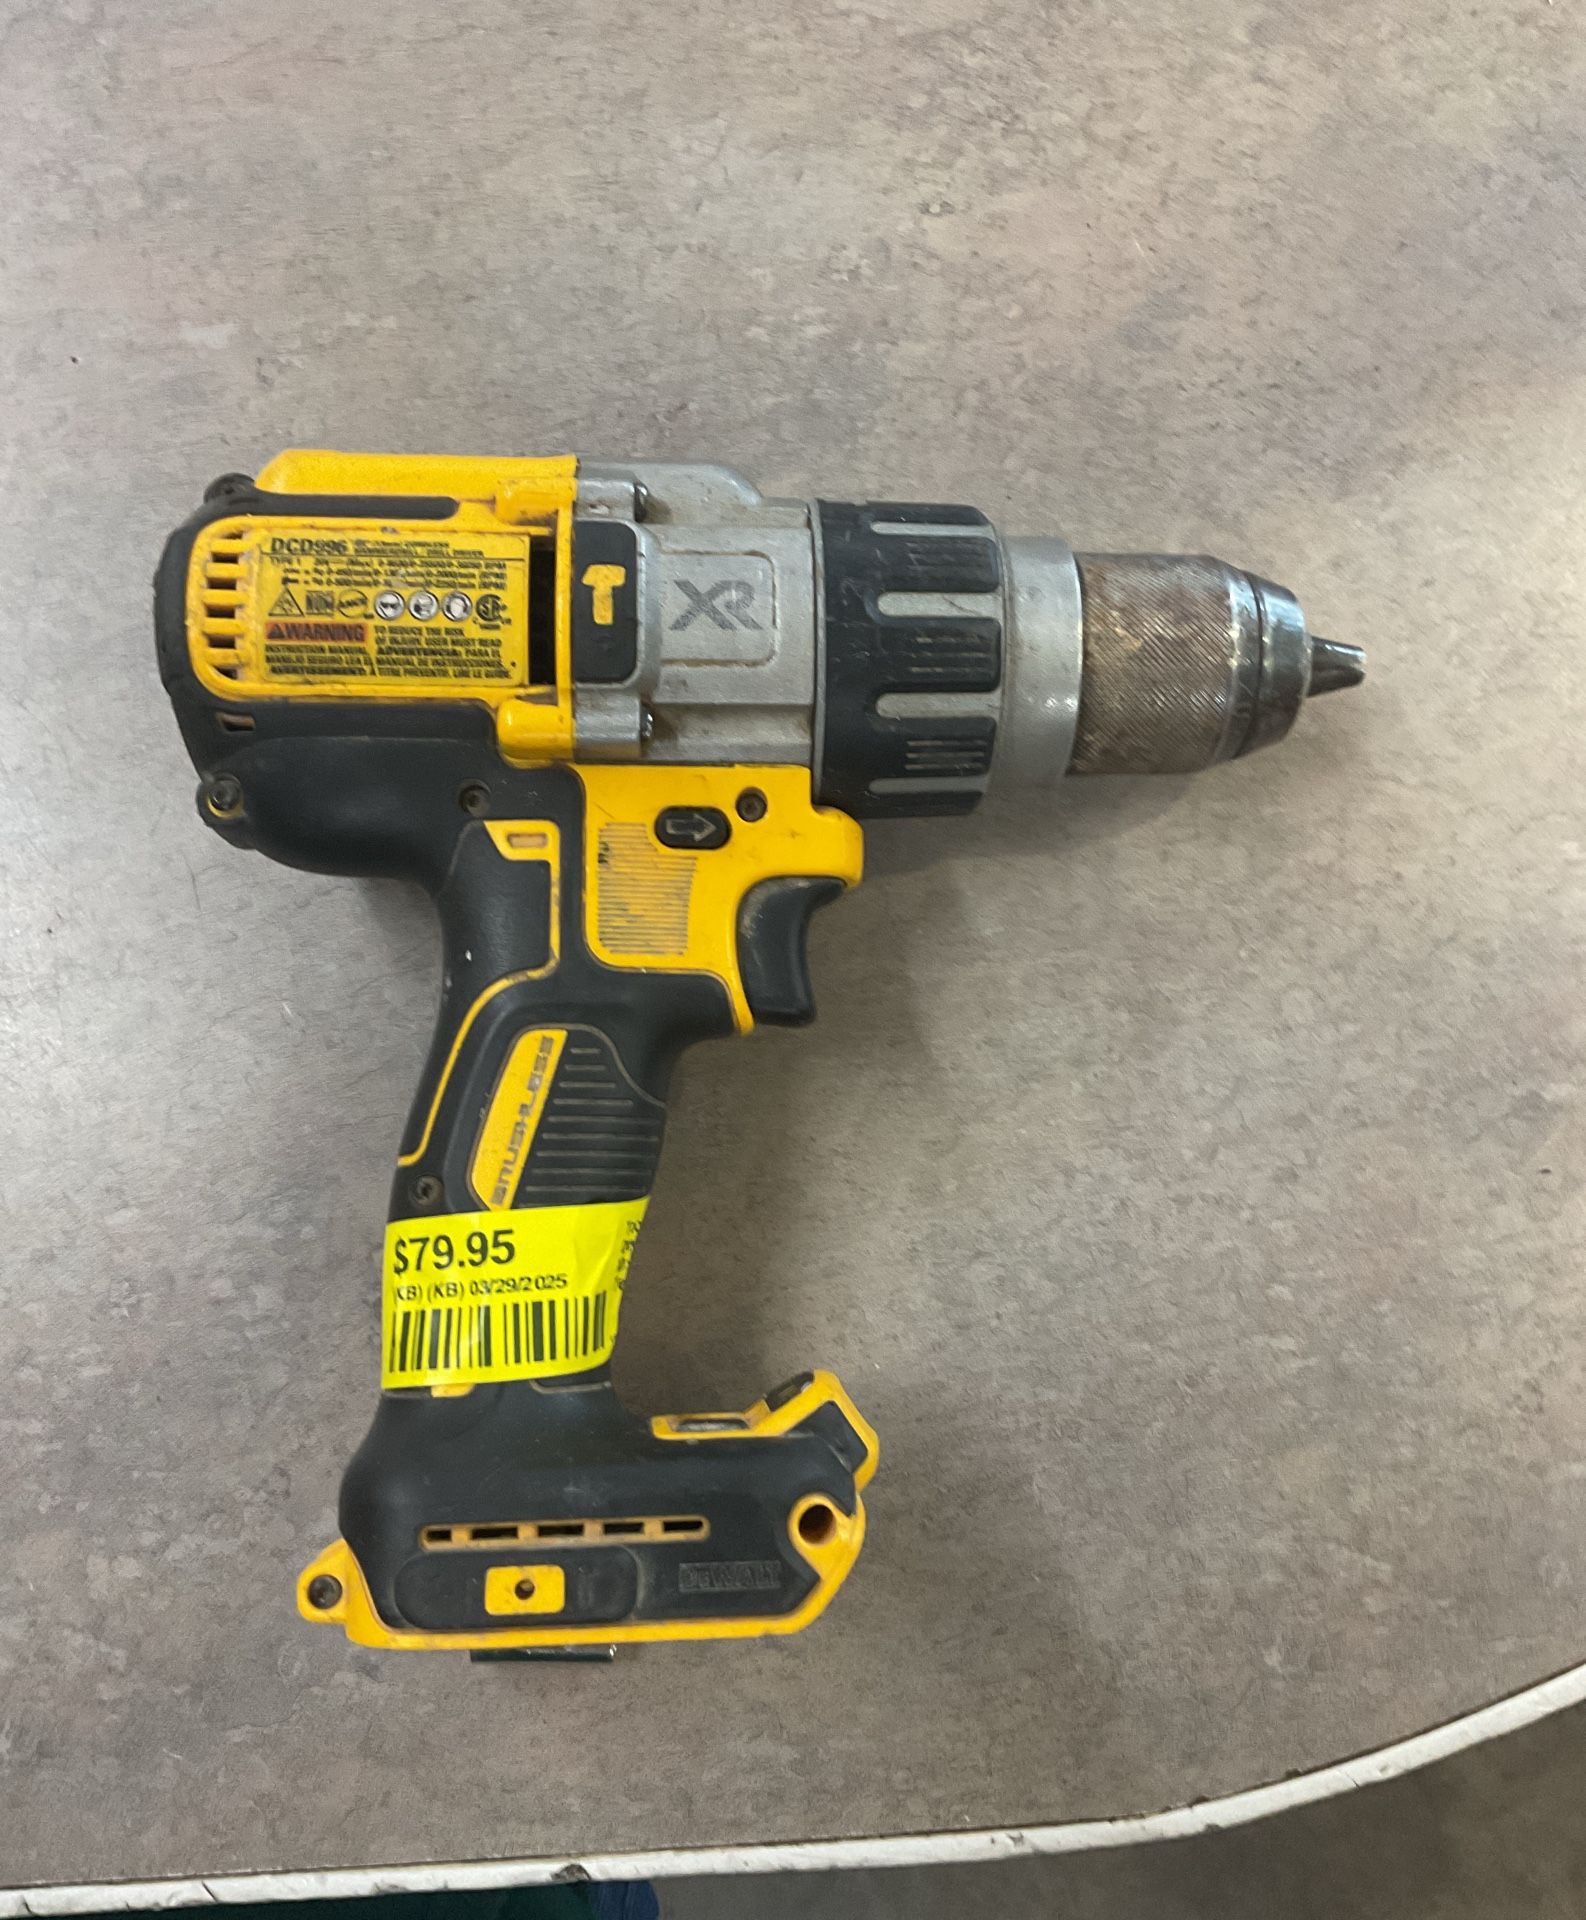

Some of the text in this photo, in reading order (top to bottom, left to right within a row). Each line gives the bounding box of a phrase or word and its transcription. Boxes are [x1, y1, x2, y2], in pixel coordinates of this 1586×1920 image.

[669, 580, 764, 631] XR
[285, 623, 365, 642] WARNING
[393, 1229, 516, 1276] $79.95
[468, 1272, 569, 1297] 03/29/2025
